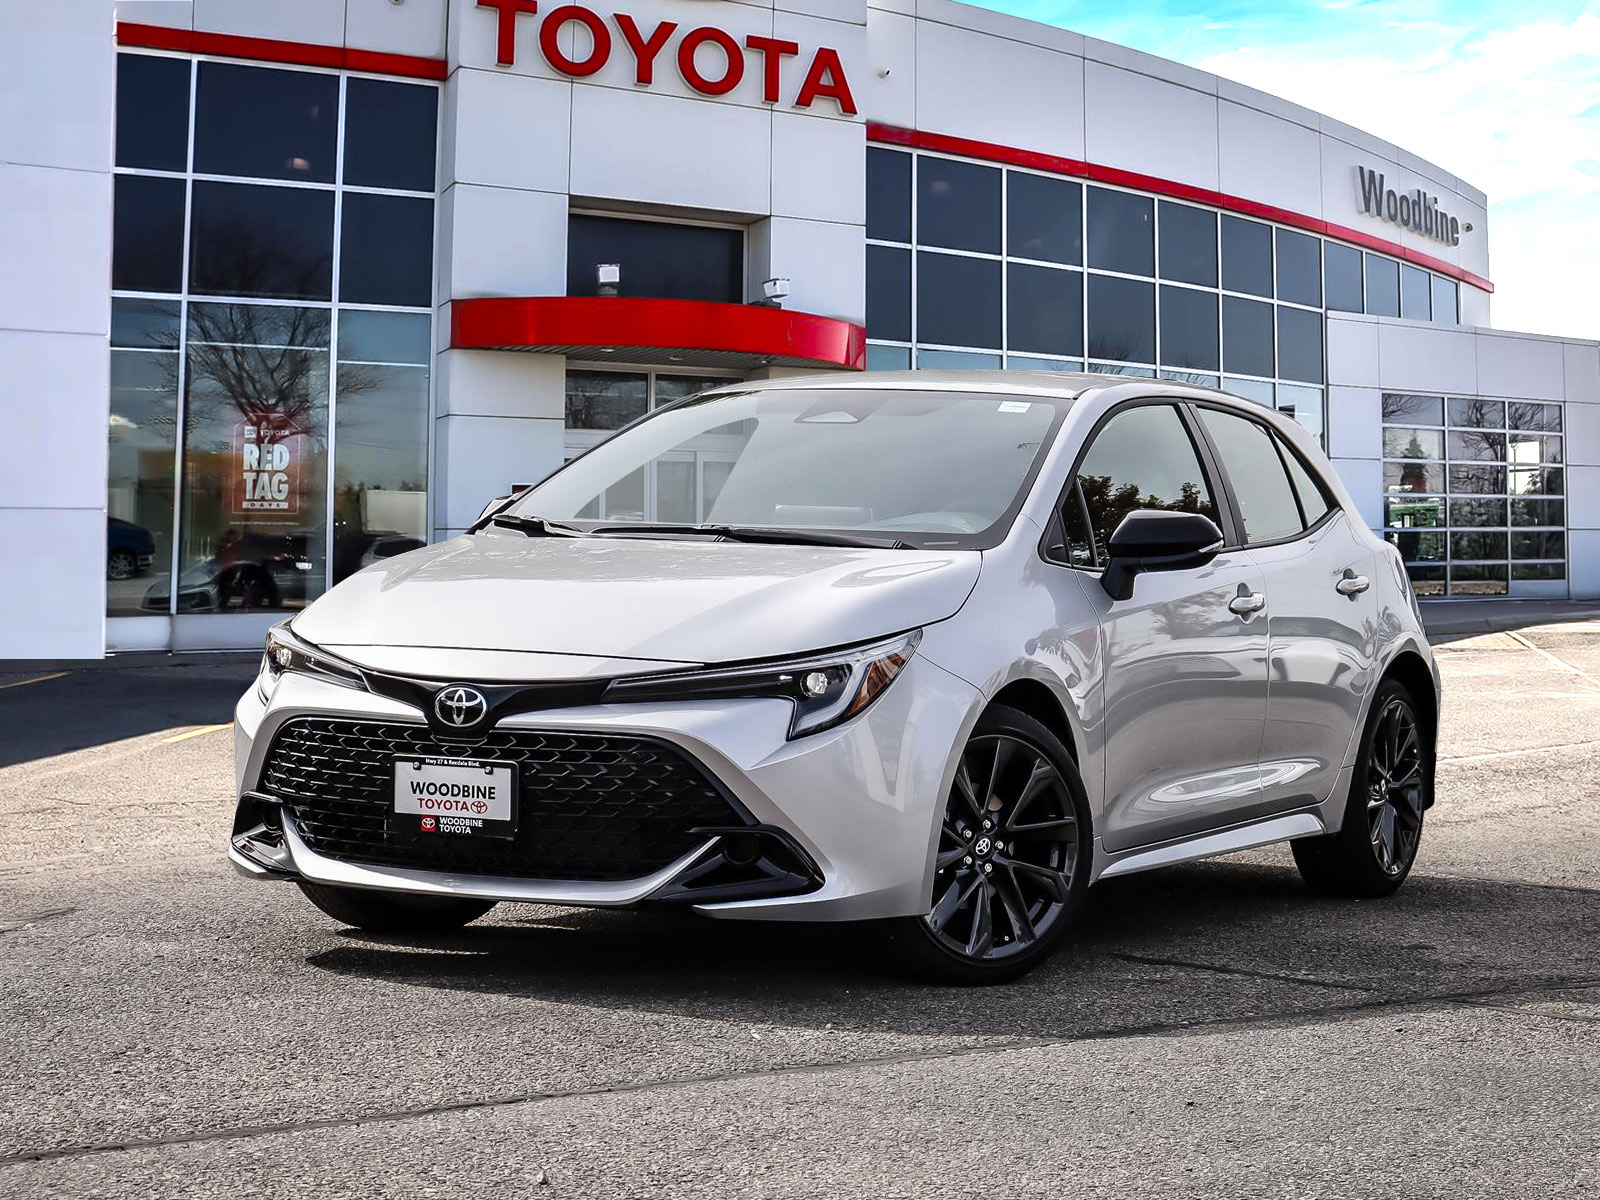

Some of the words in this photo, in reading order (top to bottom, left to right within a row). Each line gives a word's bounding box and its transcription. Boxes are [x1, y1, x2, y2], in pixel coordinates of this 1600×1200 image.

[476, 0, 858, 117] TOYOTA
[1357, 164, 1460, 247] Woodbine
[260, 429, 290, 437] TOYOTA
[243, 443, 290, 471] RED
[243, 472, 289, 501] TAG
[410, 781, 496, 800] WOODBINE
[417, 798, 470, 812] TOYOTA
[439, 817, 483, 828] WOODBINE
[439, 824, 472, 834] TOYOTA
